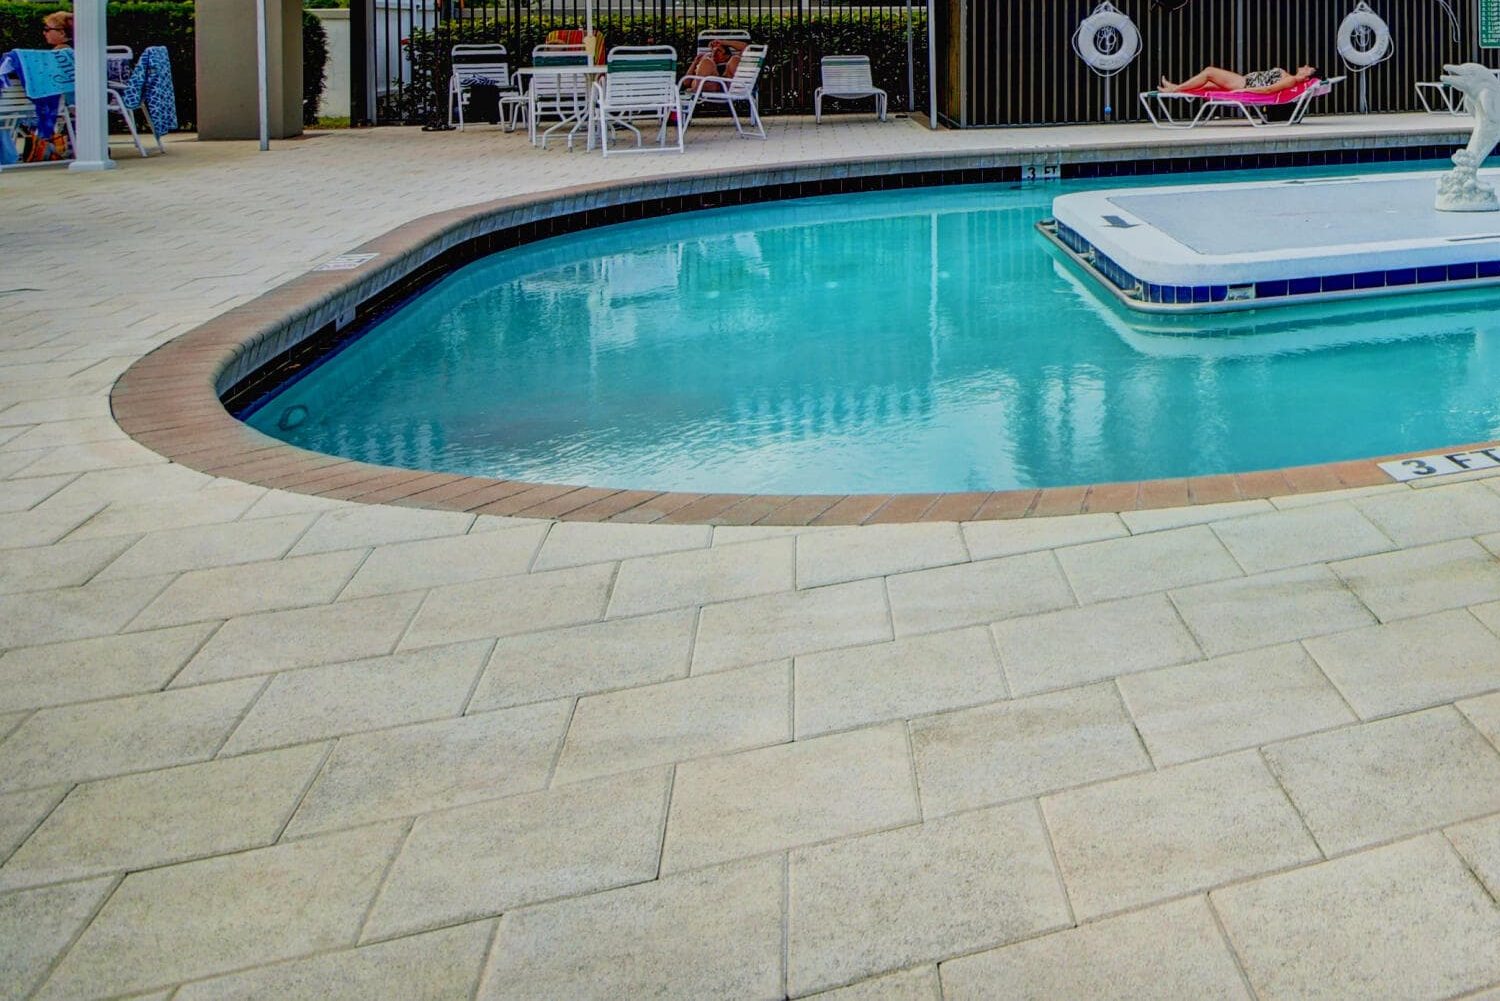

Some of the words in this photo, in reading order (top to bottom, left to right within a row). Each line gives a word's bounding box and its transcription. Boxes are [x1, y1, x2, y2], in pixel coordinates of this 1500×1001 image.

[1027, 167, 1036, 179] 3
[1044, 165, 1058, 178] FT
[1401, 459, 1437, 475] 3
